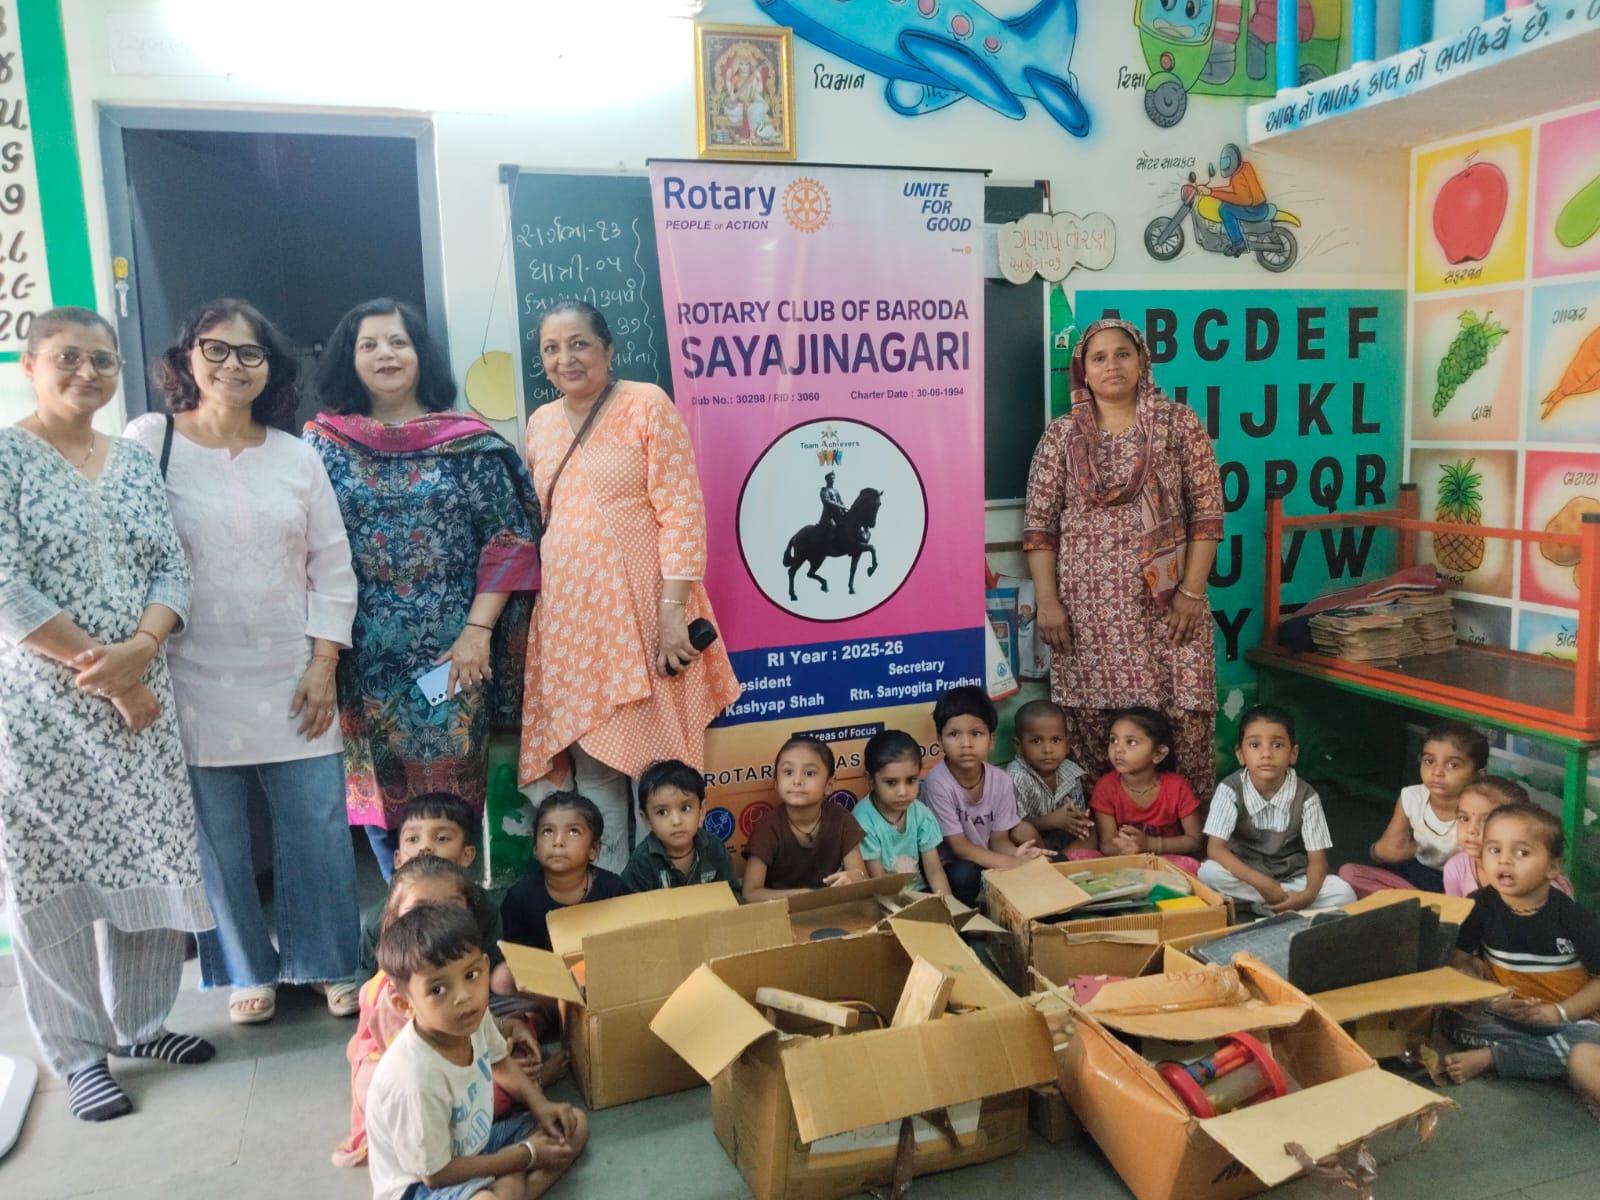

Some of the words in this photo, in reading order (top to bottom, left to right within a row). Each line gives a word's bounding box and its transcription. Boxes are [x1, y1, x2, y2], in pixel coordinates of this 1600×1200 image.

[813, 63, 865, 91] વિમાન
[664, 177, 776, 217] Rotary
[903, 182, 950, 197] UNITE
[921, 200, 952, 214] FOR
[666, 220, 711, 230] PEOPLE
[726, 220, 768, 230] ACTION
[926, 217, 972, 232] GOOD
[677, 301, 770, 325] ROTARY
[777, 301, 835, 323] CLUB
[842, 300, 870, 321] OF
[876, 300, 969, 321] BARODA
[681, 331, 969, 379] SAYAJINAGARI
[736, 394, 766, 403] 30298
[797, 392, 820, 401] 3060
[850, 390, 885, 400] Charter
[887, 390, 908, 399] Date
[917, 388, 964, 397] 30-06-1994
[767, 652, 785, 667] RI
[790, 650, 828, 664] Year
[841, 641, 904, 660] 2025-26
[888, 660, 944, 675] Secretary
[850, 688, 873, 701] Rtn.
[877, 681, 932, 698] Sanyogita
[725, 700, 785, 718] Kashyap
[790, 693, 825, 709] Shah
[838, 729, 848, 738] of
[850, 727, 877, 737] Focus
